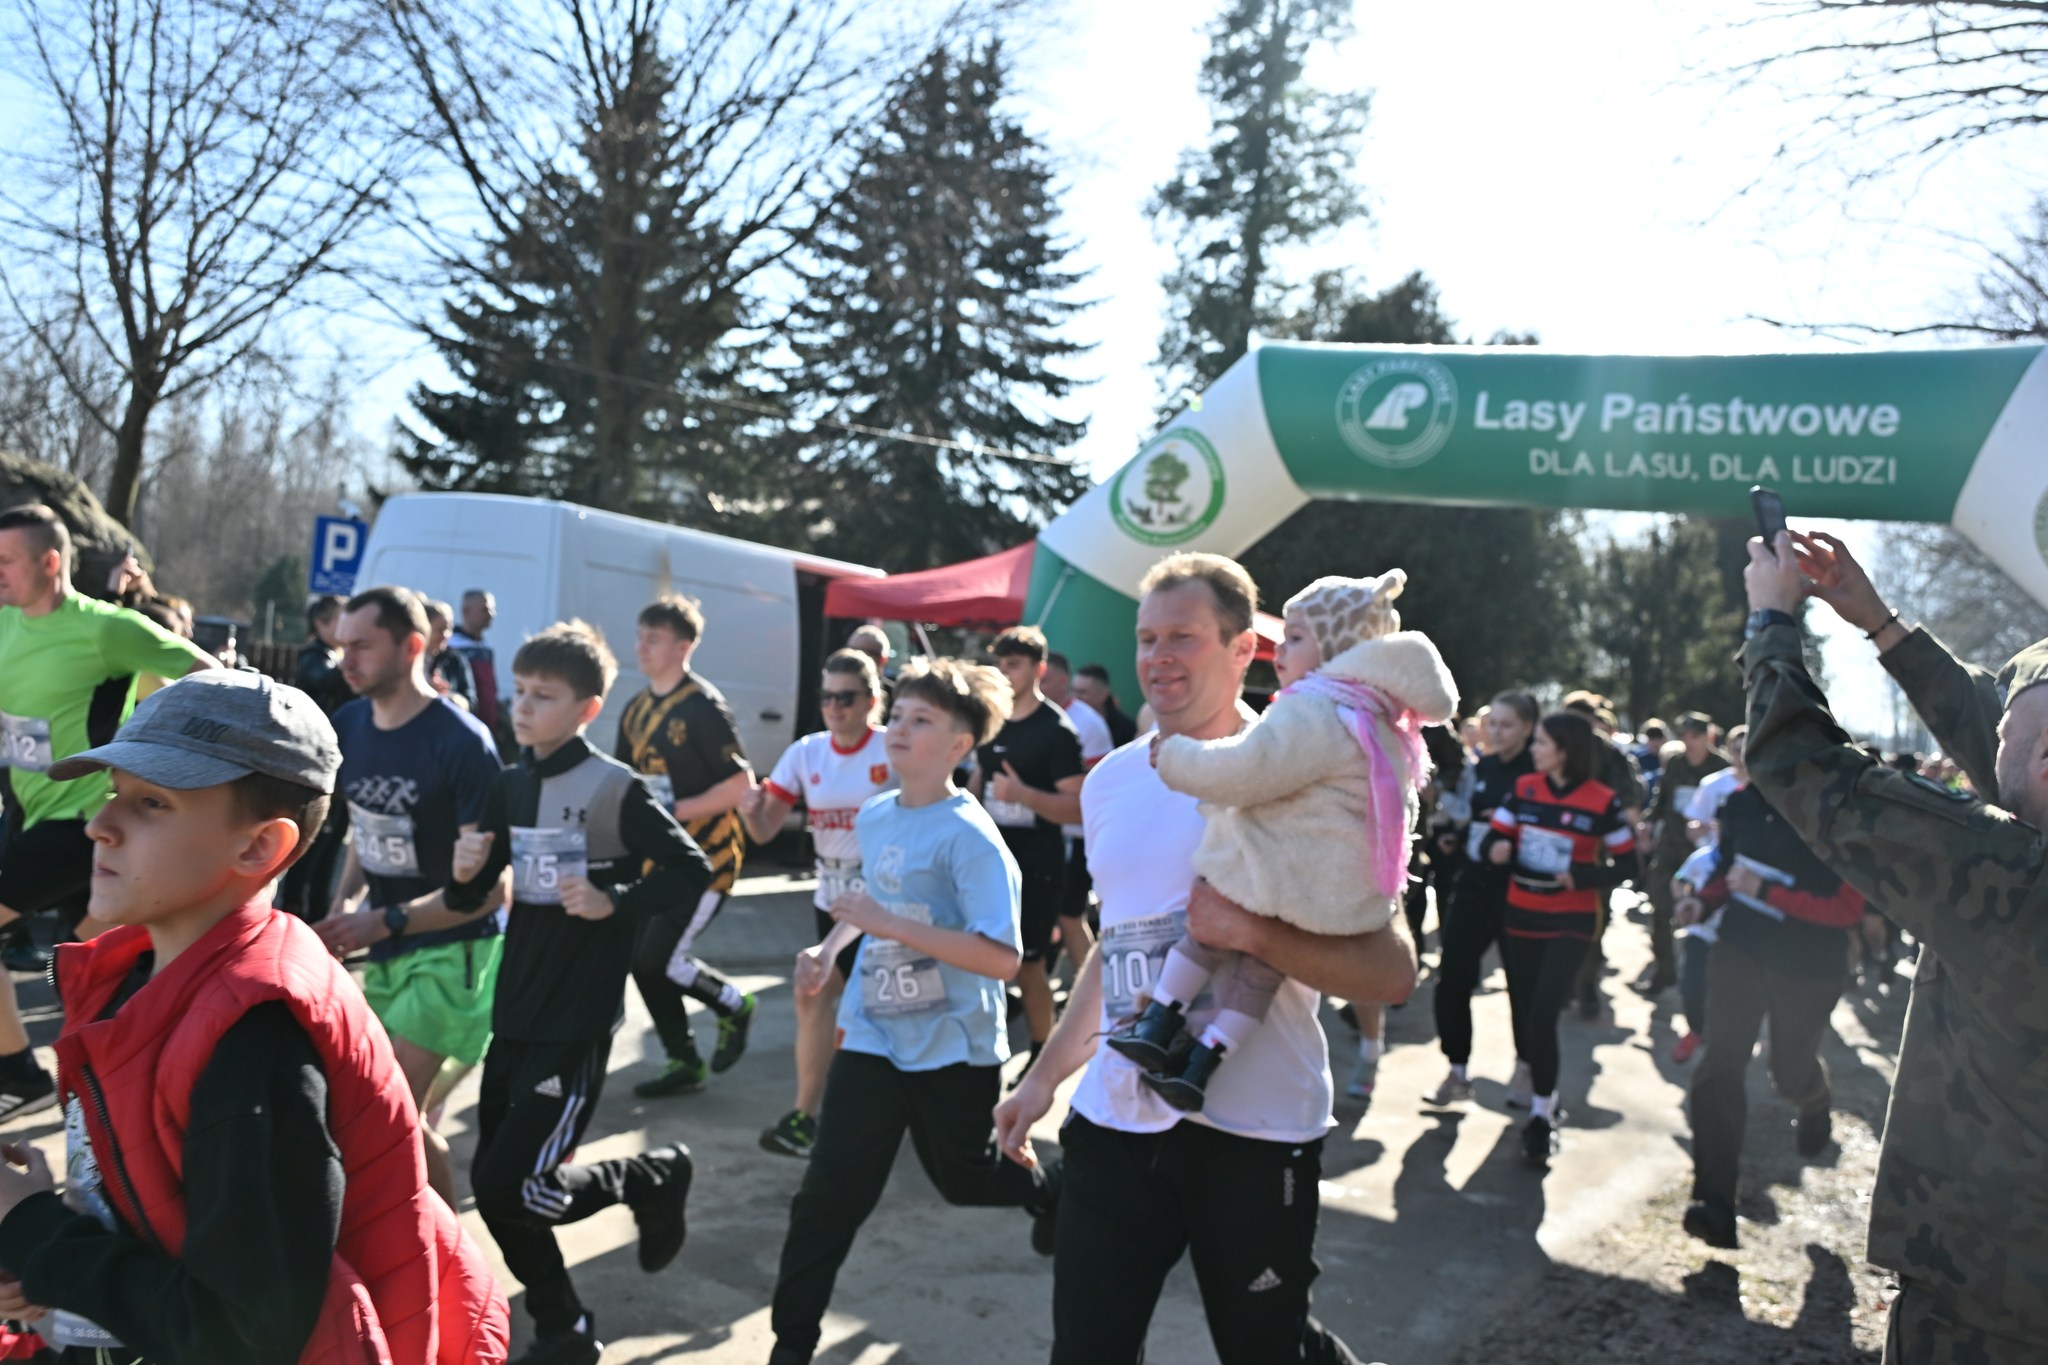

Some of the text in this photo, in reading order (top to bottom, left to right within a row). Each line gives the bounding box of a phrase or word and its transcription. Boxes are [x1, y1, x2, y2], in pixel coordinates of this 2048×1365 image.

[1474, 391, 1900, 442] Lasy Państwowe
[1529, 448, 1595, 476] DLA
[1709, 453, 1781, 482] DLA
[1792, 456, 1897, 484] LUDZI
[322, 522, 358, 571] P
[521, 854, 558, 888] 75
[874, 964, 919, 1001] 26
[1108, 949, 1151, 999] 10
